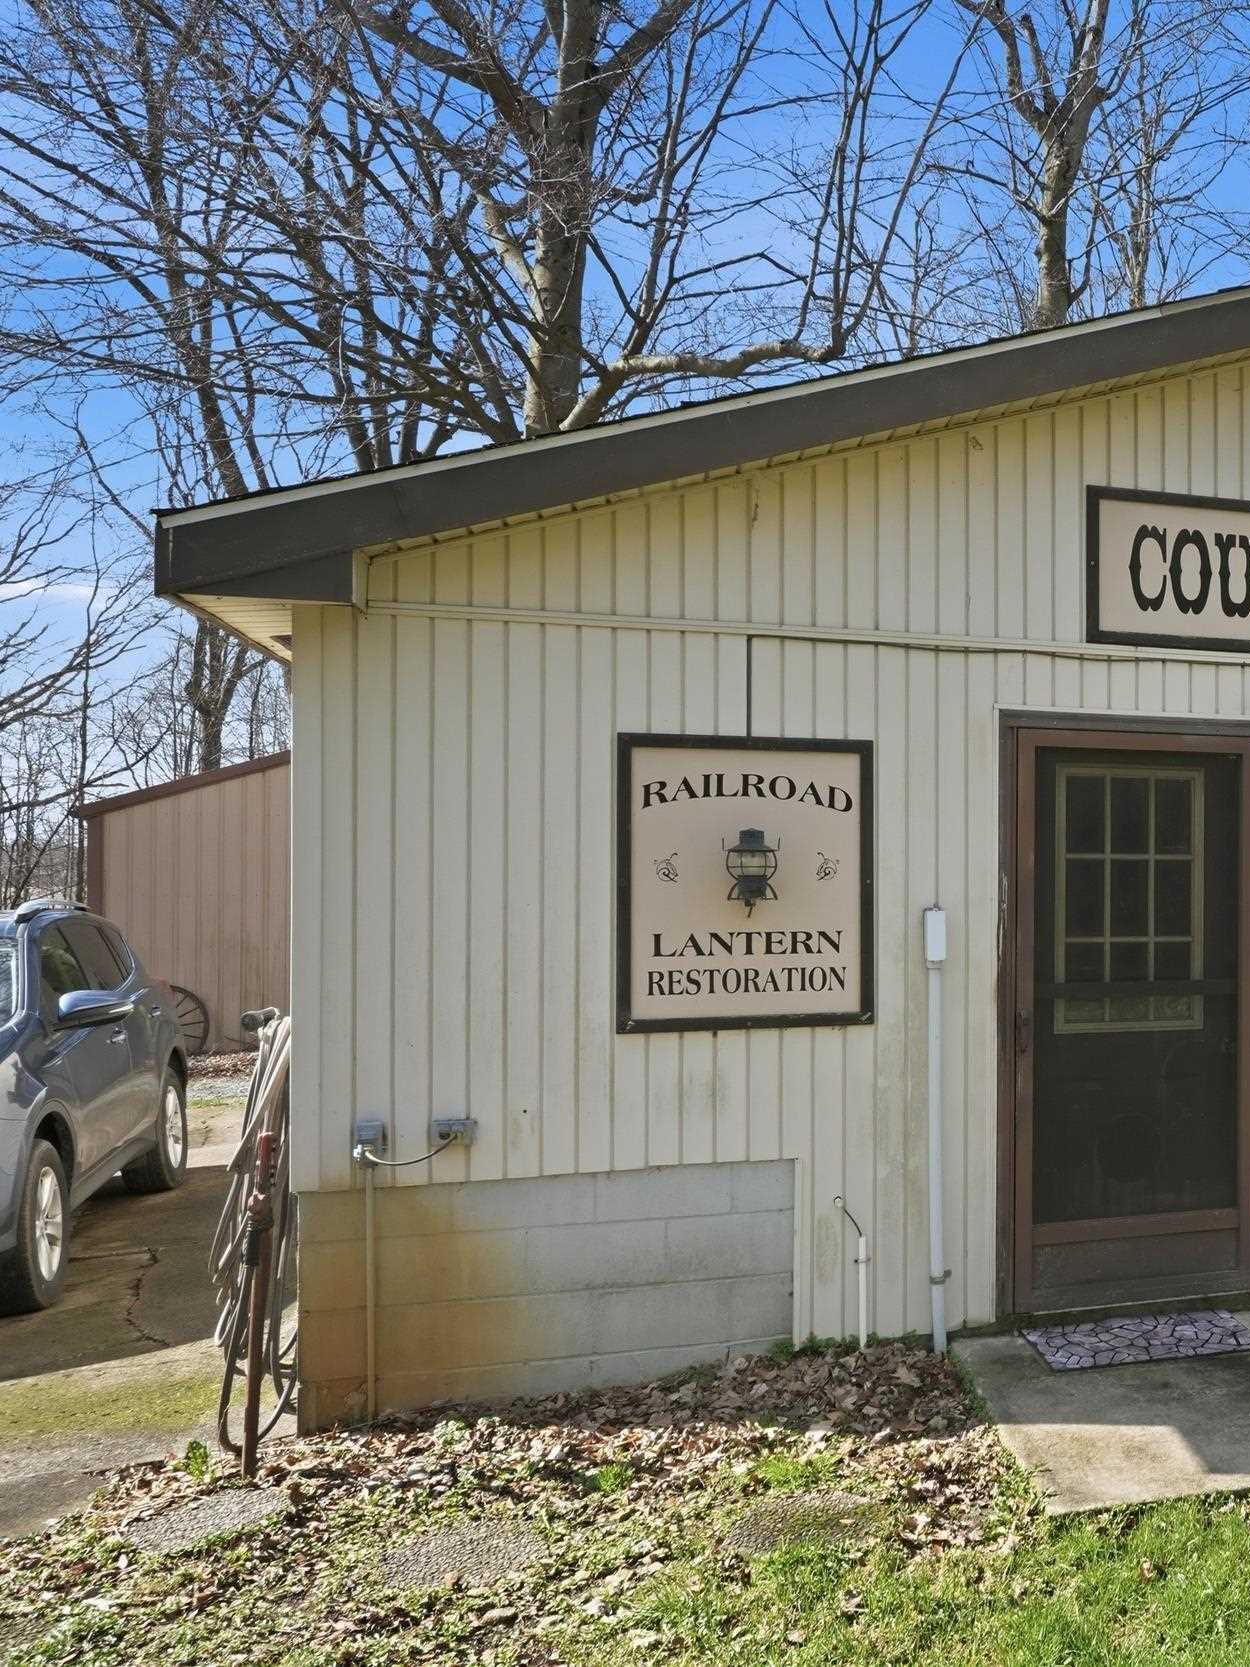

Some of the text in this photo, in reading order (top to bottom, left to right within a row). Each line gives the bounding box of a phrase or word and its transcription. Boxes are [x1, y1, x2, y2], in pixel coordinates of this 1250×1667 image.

[641, 772, 853, 813] RAILROAD
[652, 930, 843, 957] LANTERN
[647, 966, 847, 996] RESTORATION
